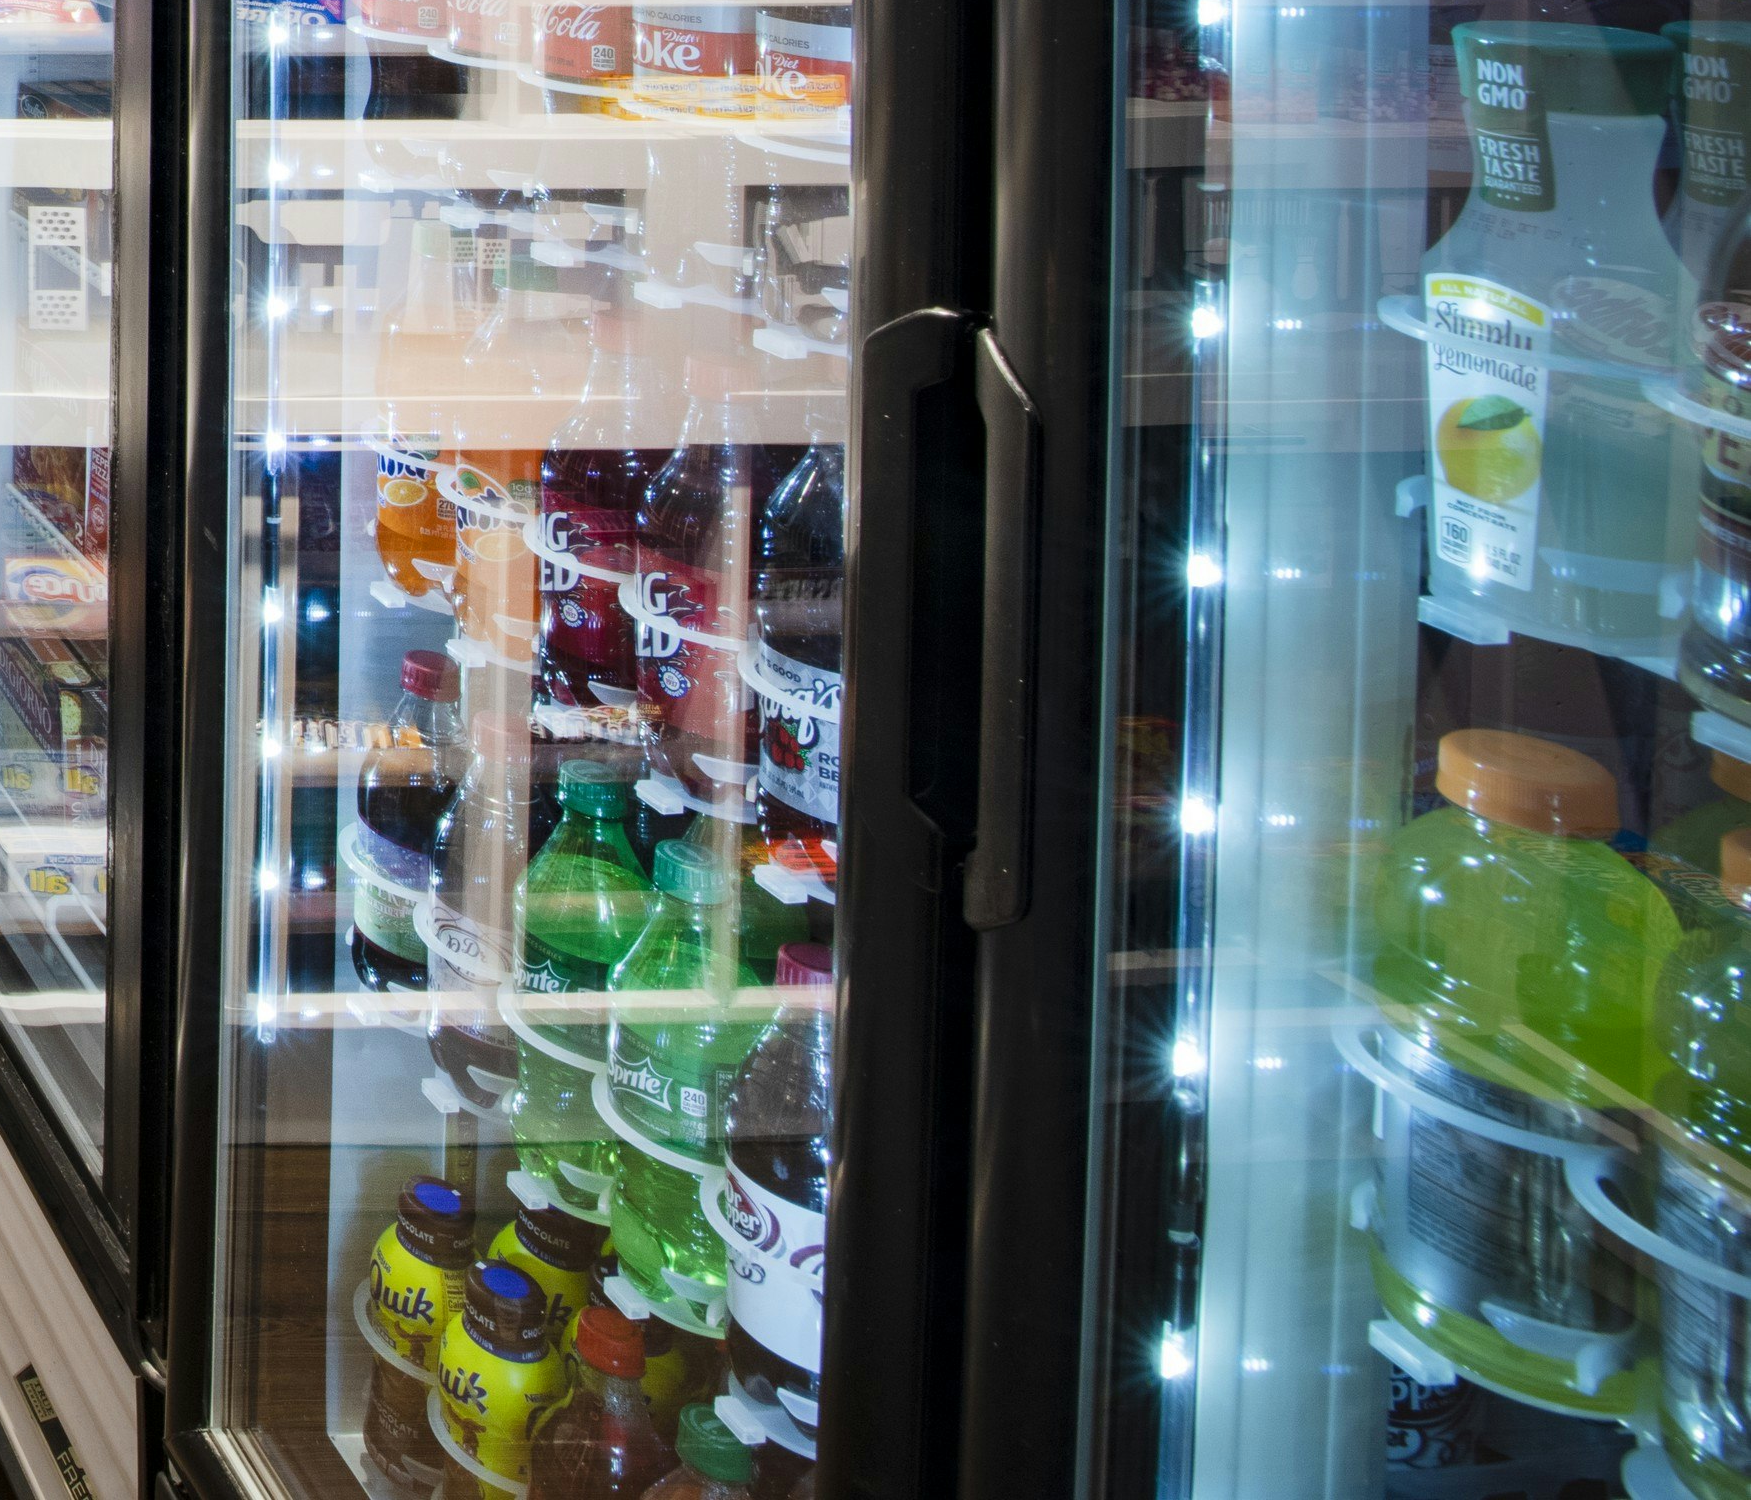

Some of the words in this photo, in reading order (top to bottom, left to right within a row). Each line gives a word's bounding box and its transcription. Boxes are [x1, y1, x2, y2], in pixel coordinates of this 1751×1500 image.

[420, 9, 437, 17] 240
[657, 11, 702, 24] CALORIES
[593, 47, 613, 58] 240
[769, 36, 810, 49] CALORIES
[773, 53, 798, 69] Diet
[1476, 58, 1525, 87] NON
[1684, 52, 1729, 81] NON
[1478, 86, 1527, 111] GMO
[1683, 76, 1731, 104] GMO
[1478, 134, 1540, 164] FRESH
[1684, 131, 1744, 158] FRESH
[1484, 156, 1540, 183] TASTE
[1688, 152, 1746, 180] TASTE
[1484, 176, 1542, 196] GUARANTEED
[1440, 283, 1461, 294] ALL
[1464, 285, 1529, 316] NATURAL
[1435, 300, 1533, 351] Simply
[1432, 343, 1537, 393] Lemonade
[1443, 521, 1469, 544] 160
[772, 663, 801, 683] GOOD
[609, 1054, 666, 1099] Sprite
[518, 1210, 571, 1249] CHOCOLATE
[370, 1259, 435, 1326] Quik
